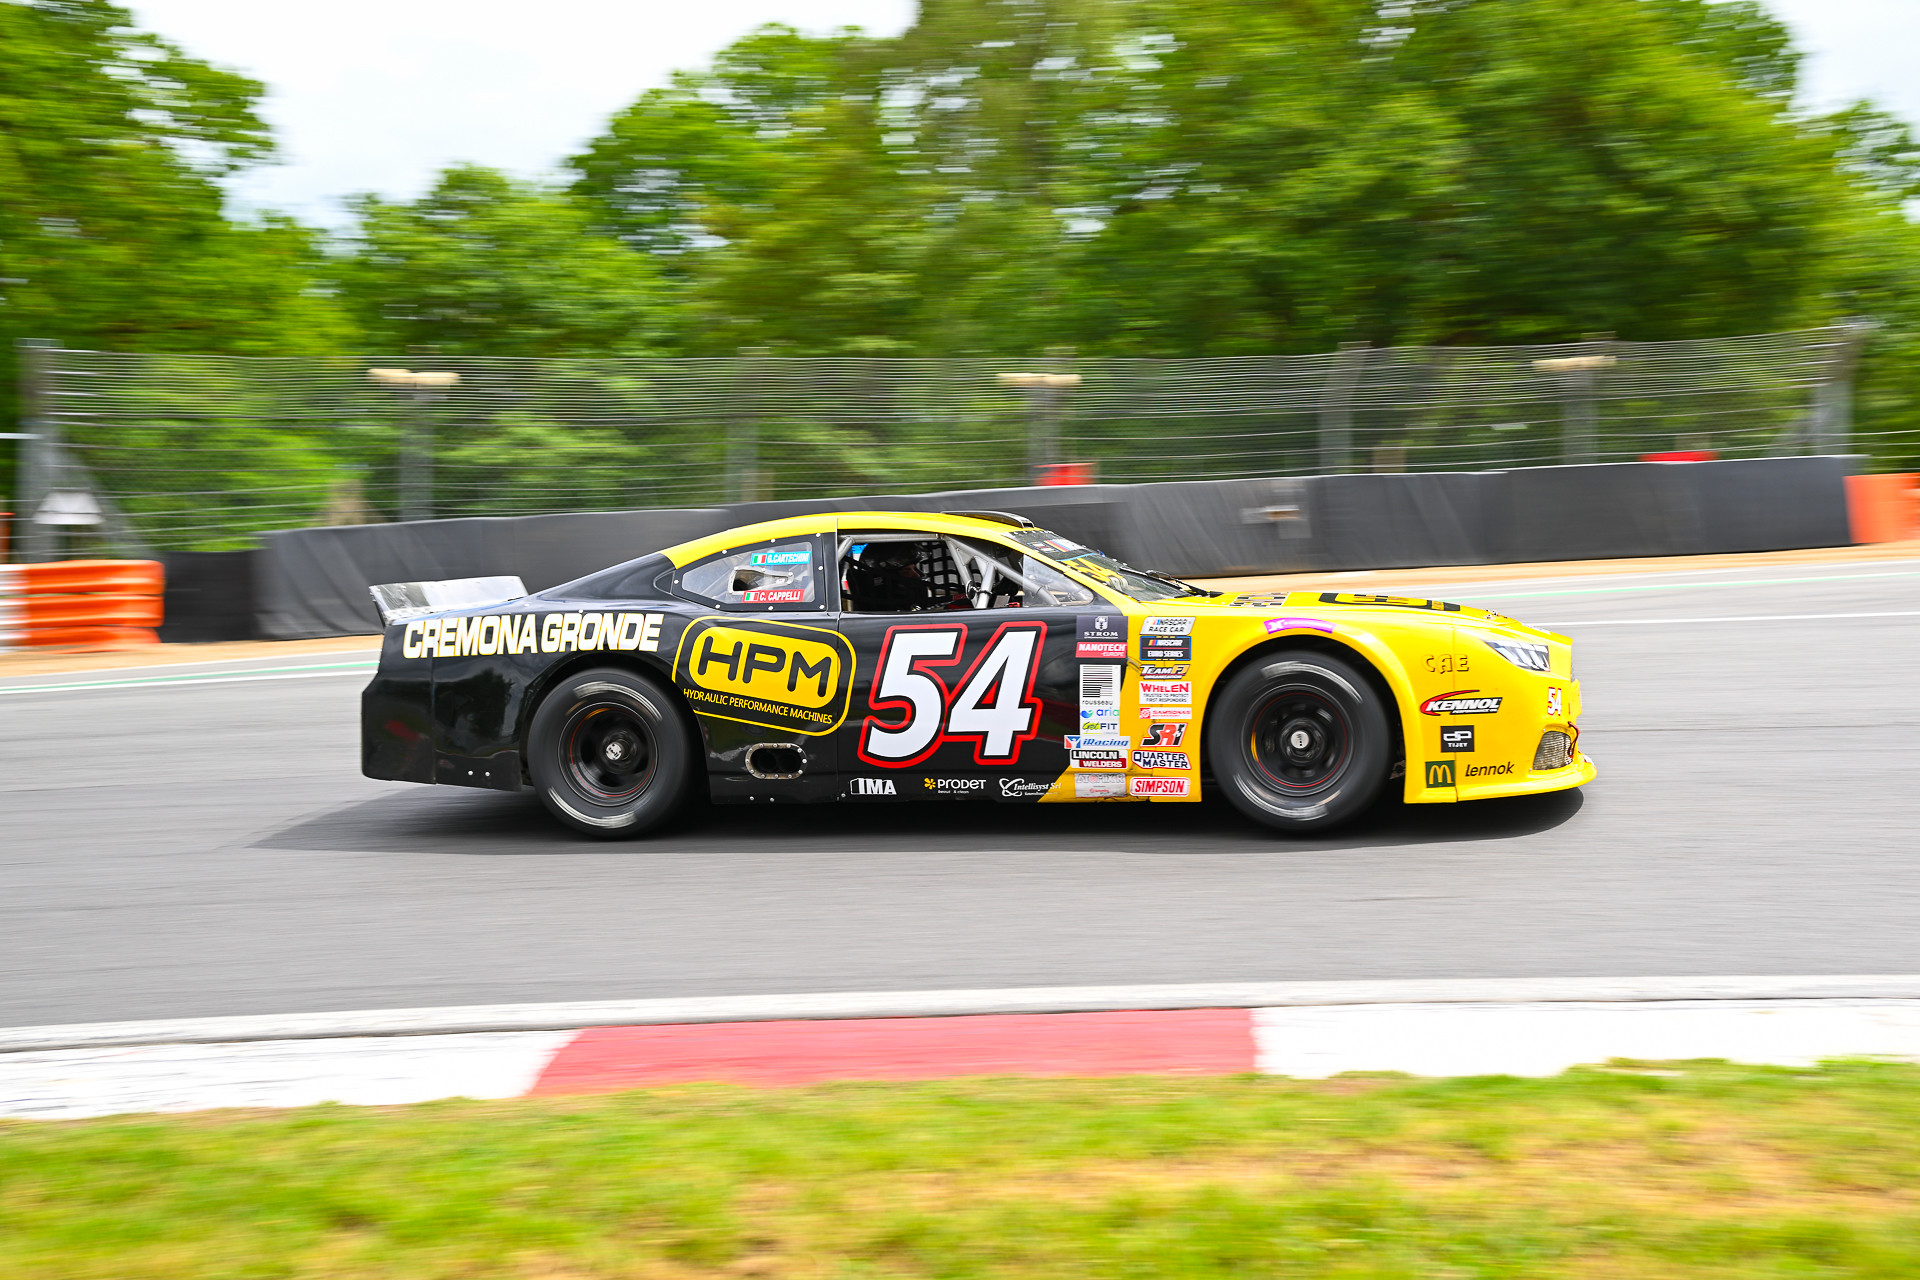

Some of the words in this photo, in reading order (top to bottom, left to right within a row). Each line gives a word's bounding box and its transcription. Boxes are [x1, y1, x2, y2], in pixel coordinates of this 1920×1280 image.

[760, 592, 767, 601] C.
[768, 591, 801, 601] CAPPELLI
[402, 614, 539, 659] CREMONA
[541, 612, 665, 653] GRONDE
[1078, 643, 1127, 652] NANOTECH
[697, 635, 832, 698] HPM
[1422, 654, 1469, 674] CAE
[1140, 682, 1189, 692] WHELEN
[862, 626, 1042, 763] 54
[1547, 686, 1562, 716] 54
[683, 688, 728, 706] HYDRAULIC
[729, 697, 789, 716] PERFORMANCE
[789, 708, 833, 725] MACHINES
[1425, 698, 1502, 712] KENNOL
[1096, 707, 1120, 717] aria
[1083, 739, 1129, 747] iRacing
[1073, 751, 1118, 760] LINCOLN
[1133, 751, 1186, 762] QUARTER
[1142, 759, 1189, 768] MASTER
[1465, 761, 1515, 777] lennok
[855, 778, 897, 795] IMA
[1134, 780, 1185, 793] SIMPSON
